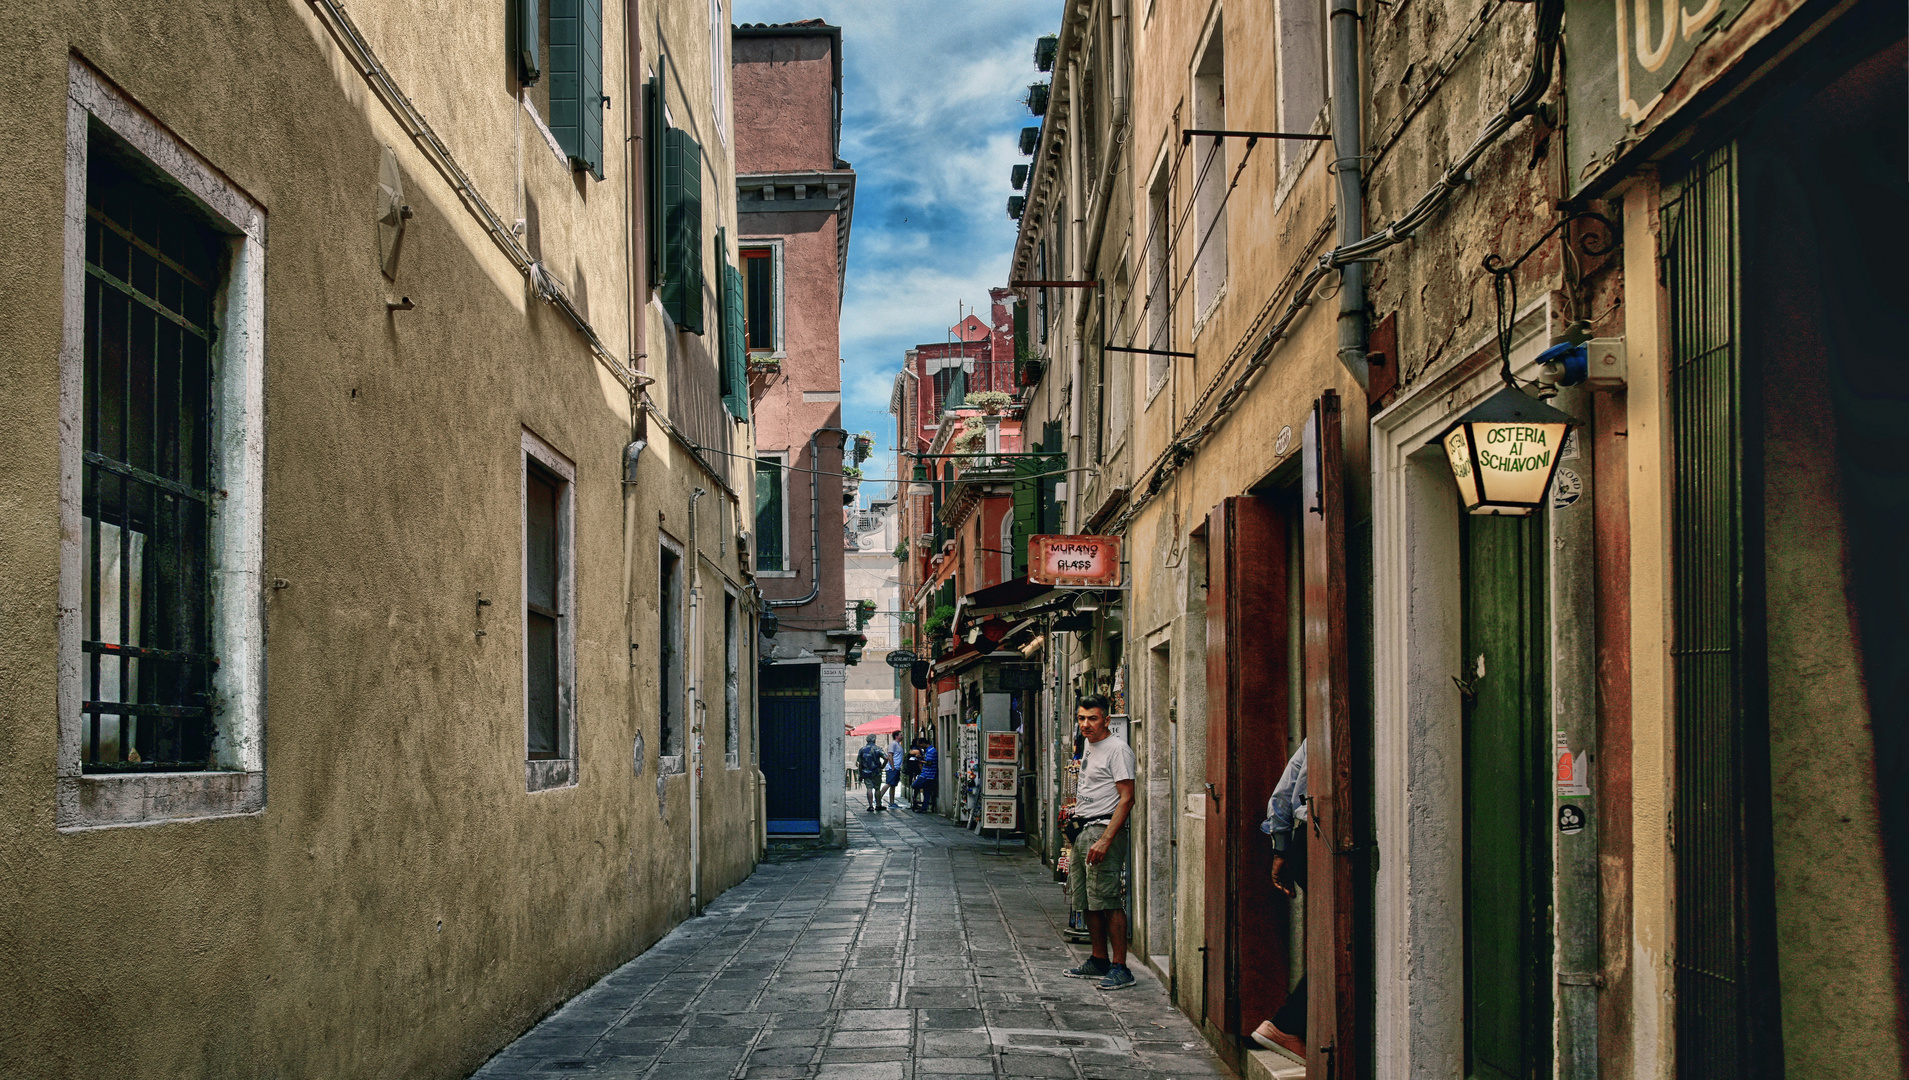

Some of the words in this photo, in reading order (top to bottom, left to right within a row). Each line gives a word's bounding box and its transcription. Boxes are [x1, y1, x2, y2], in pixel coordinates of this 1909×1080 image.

[1487, 427, 1547, 447] OSTERIA
[1509, 442, 1523, 456] AI
[1480, 450, 1551, 472] SCHIAVONI
[1559, 468, 1581, 490] NORD
[1051, 543, 1099, 554] MURANO
[1057, 559, 1092, 571] GLASS
